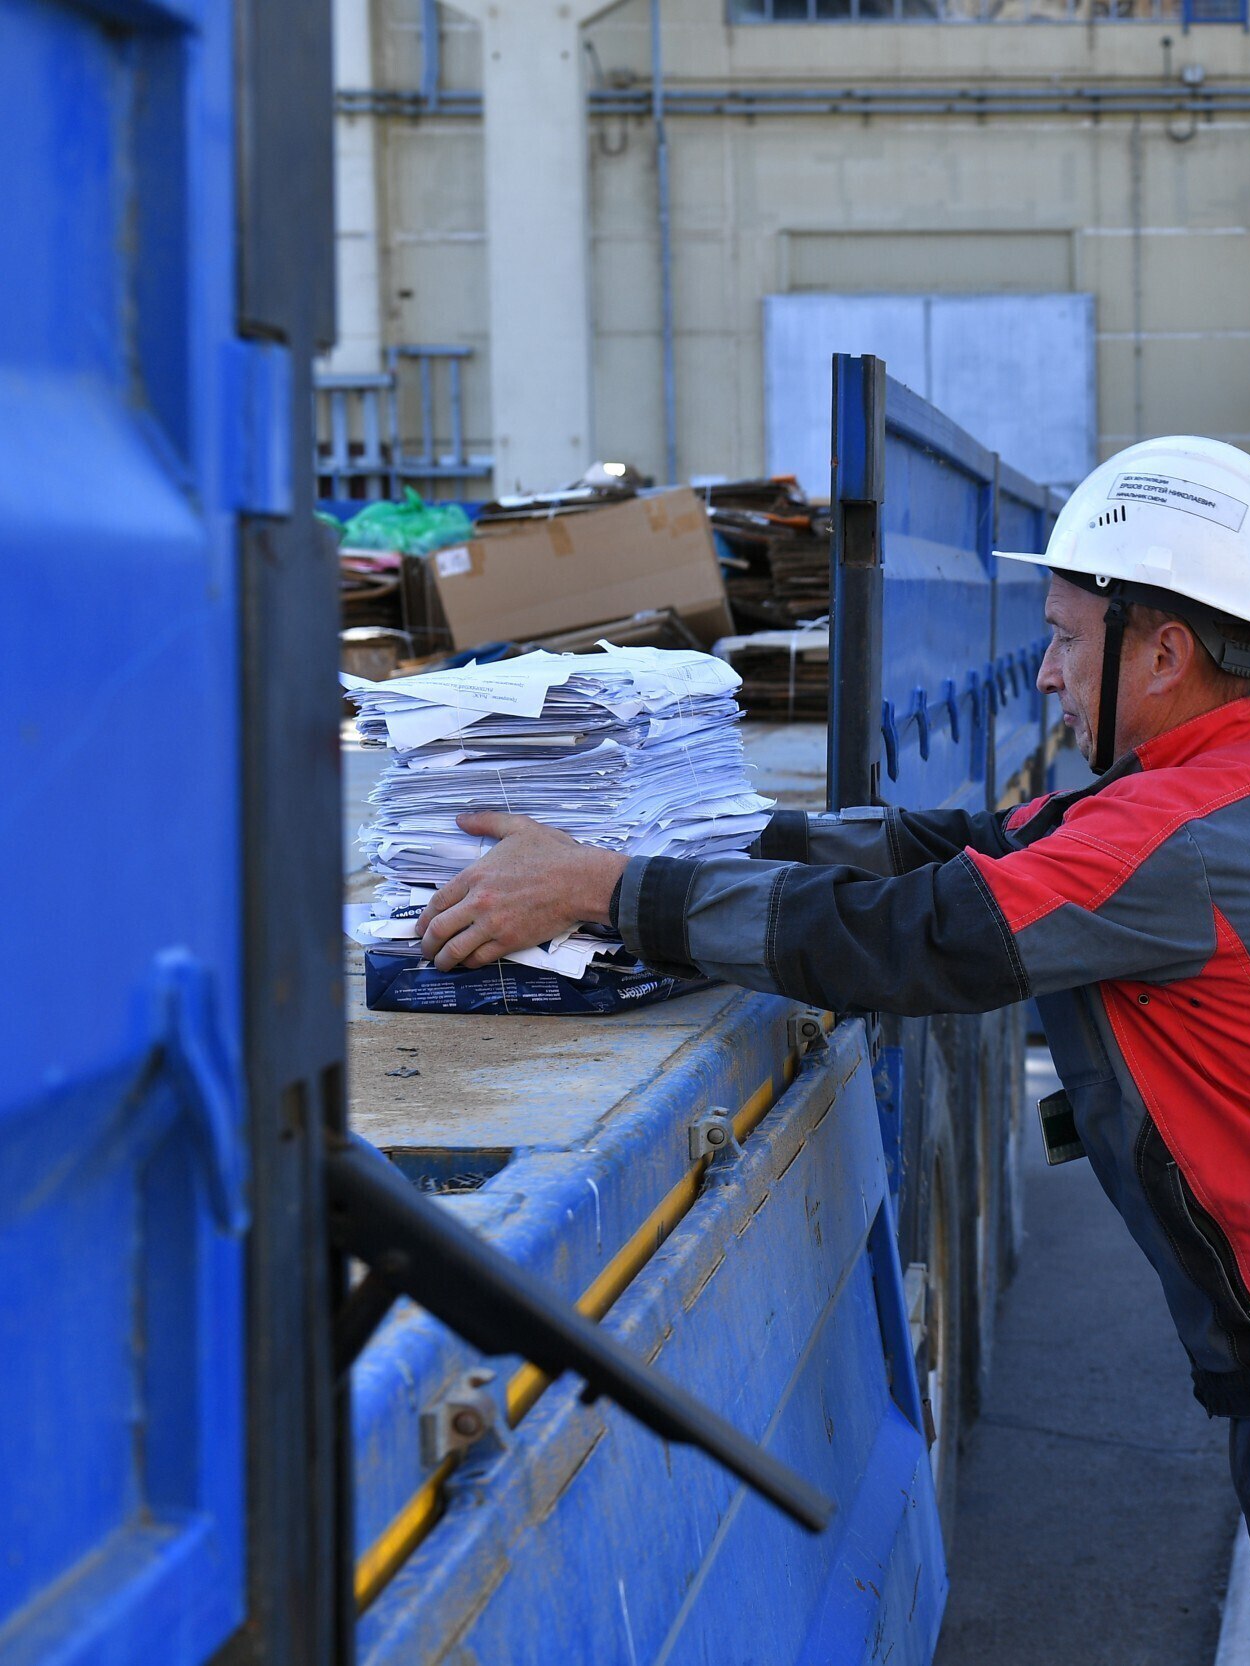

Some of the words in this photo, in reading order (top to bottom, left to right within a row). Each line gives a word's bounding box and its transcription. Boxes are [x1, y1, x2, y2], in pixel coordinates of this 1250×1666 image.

[1134, 476, 1169, 484] ВЕНТИЛЯЦИИ
[1143, 485, 1168, 494] СЕРГЕЙ
[1168, 489, 1216, 508] НИКОЛАЕВИЧ
[1147, 495, 1167, 503] СМЕНЫ
